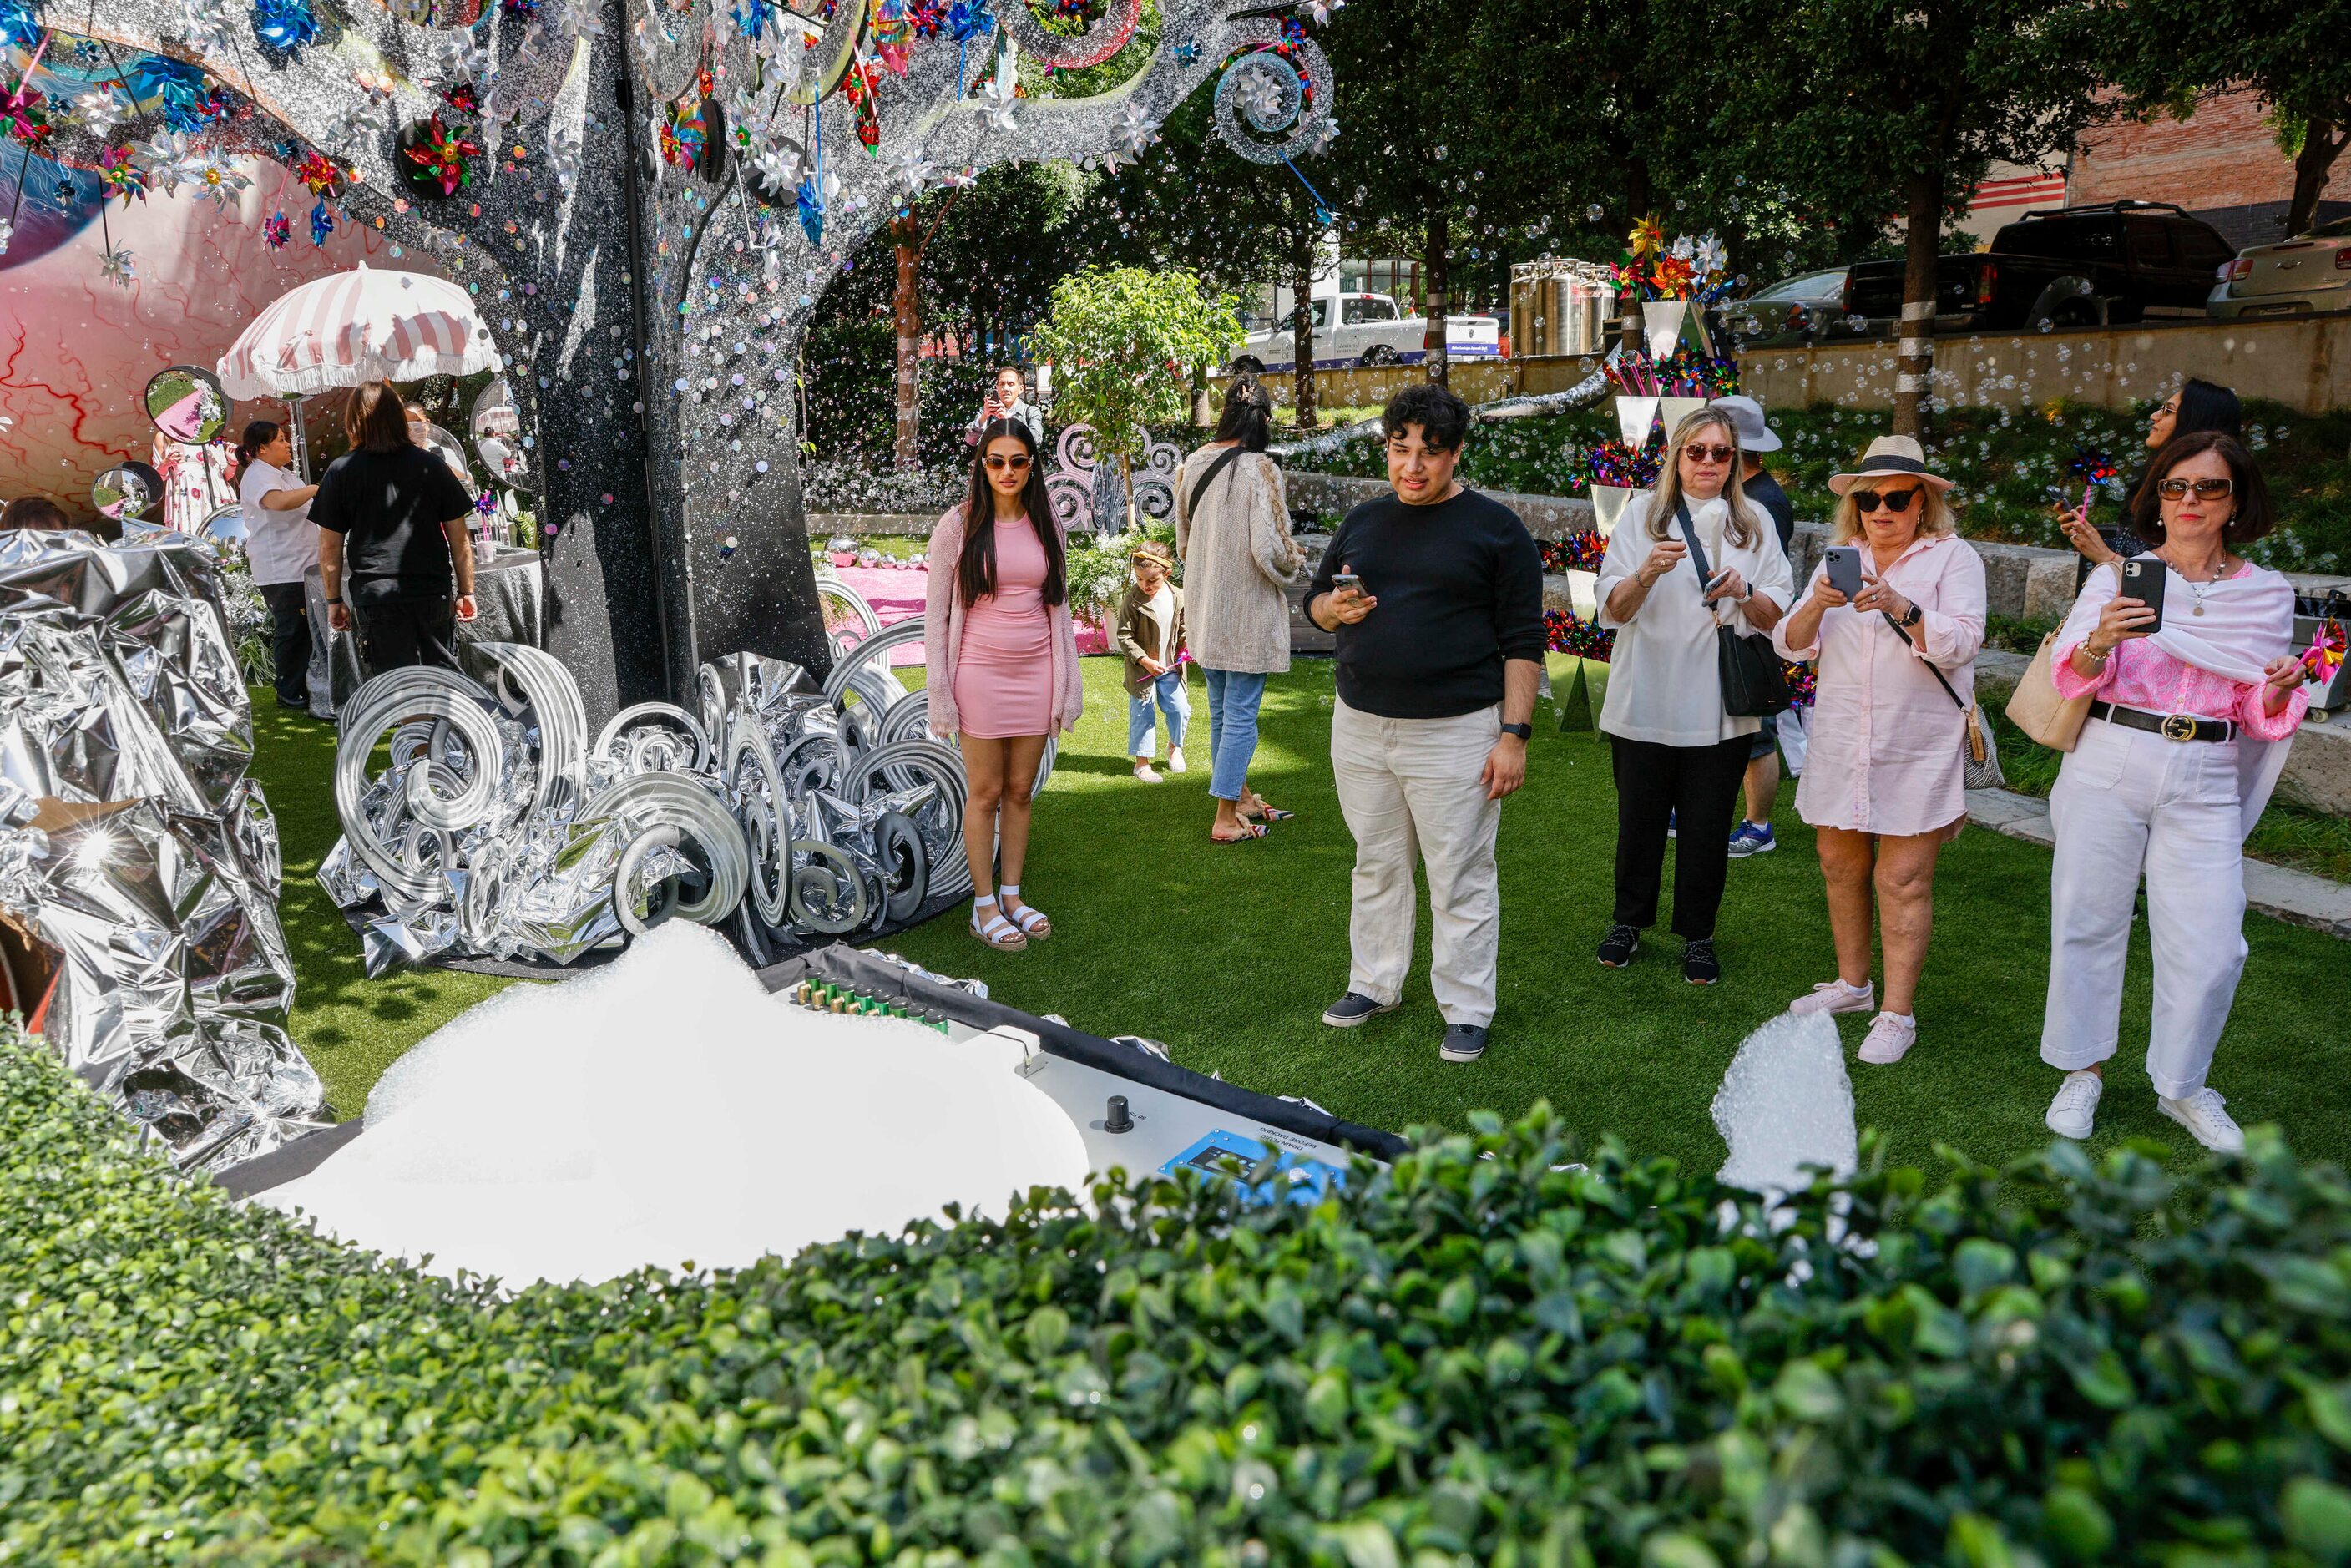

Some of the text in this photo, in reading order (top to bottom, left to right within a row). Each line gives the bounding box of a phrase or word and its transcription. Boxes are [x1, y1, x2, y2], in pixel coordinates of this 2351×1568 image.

[1259, 1127, 1318, 1149] BEFORE PACKING
[1261, 1134, 1303, 1151] DRAIN FLUID
